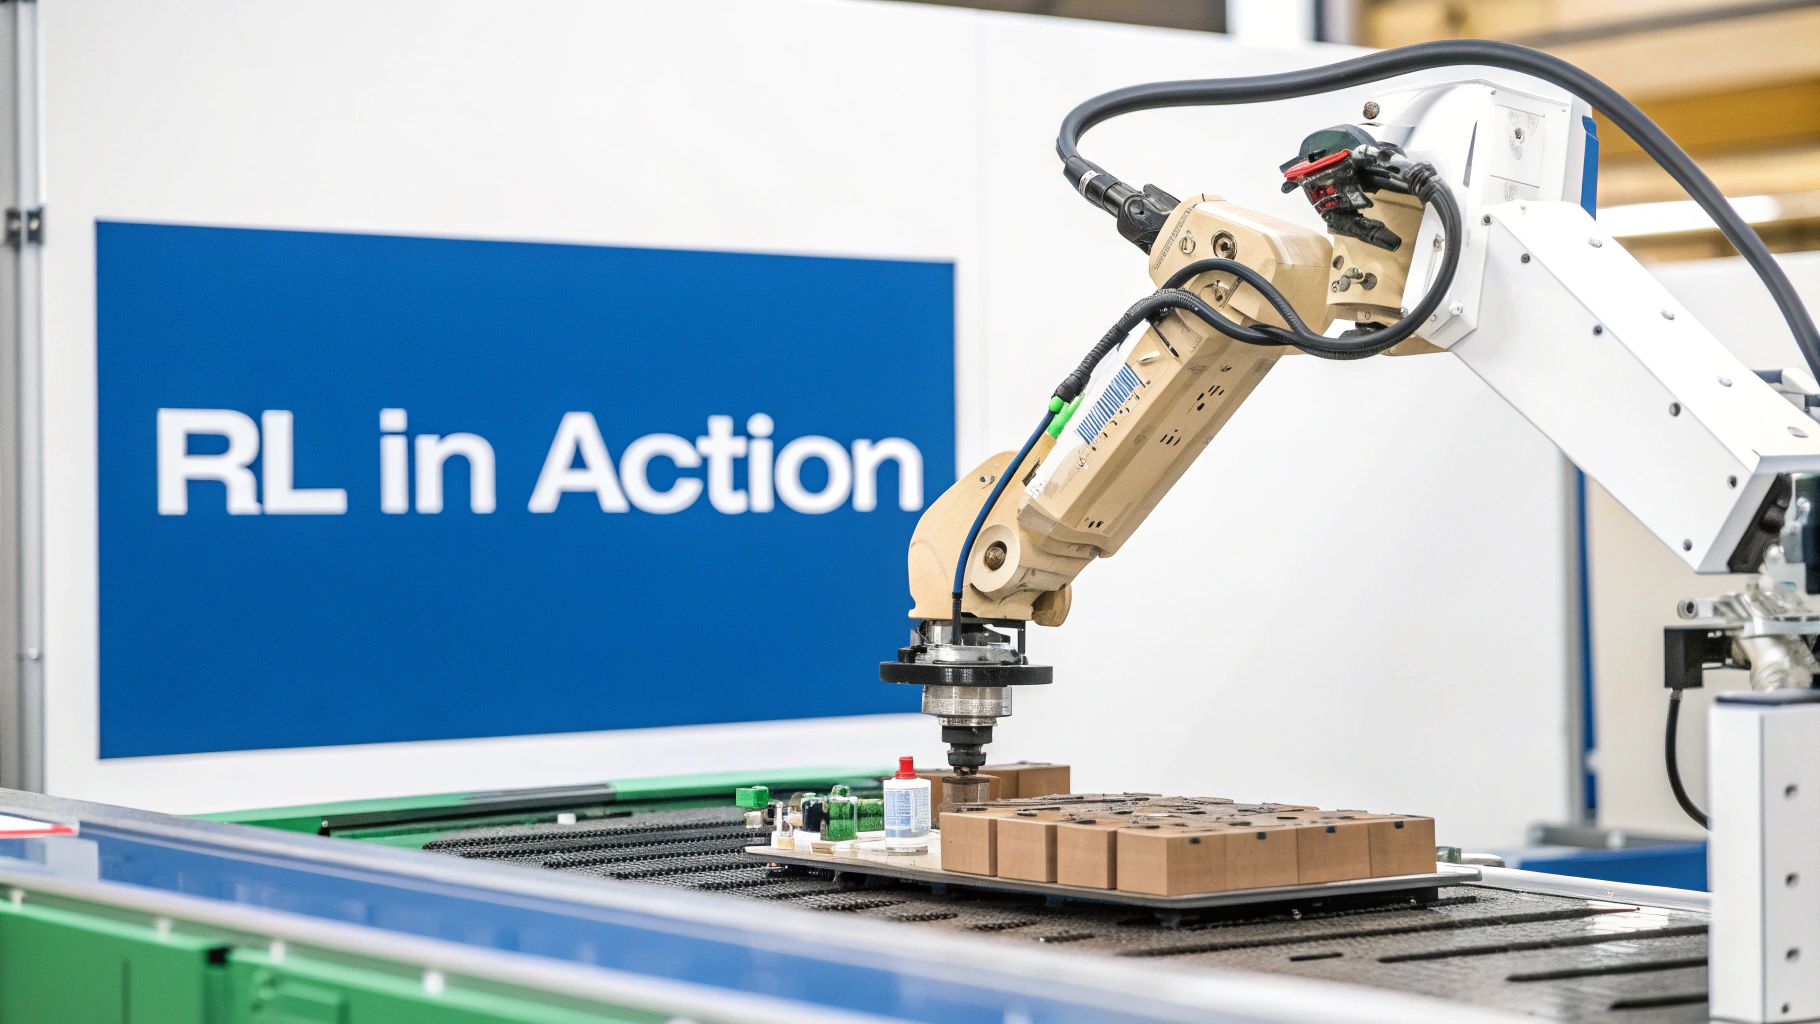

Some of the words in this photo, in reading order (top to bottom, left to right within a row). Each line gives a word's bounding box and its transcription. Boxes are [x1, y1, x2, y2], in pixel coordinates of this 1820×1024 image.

[157, 407, 348, 515] RL
[379, 408, 496, 514] in
[528, 411, 924, 515] Action
